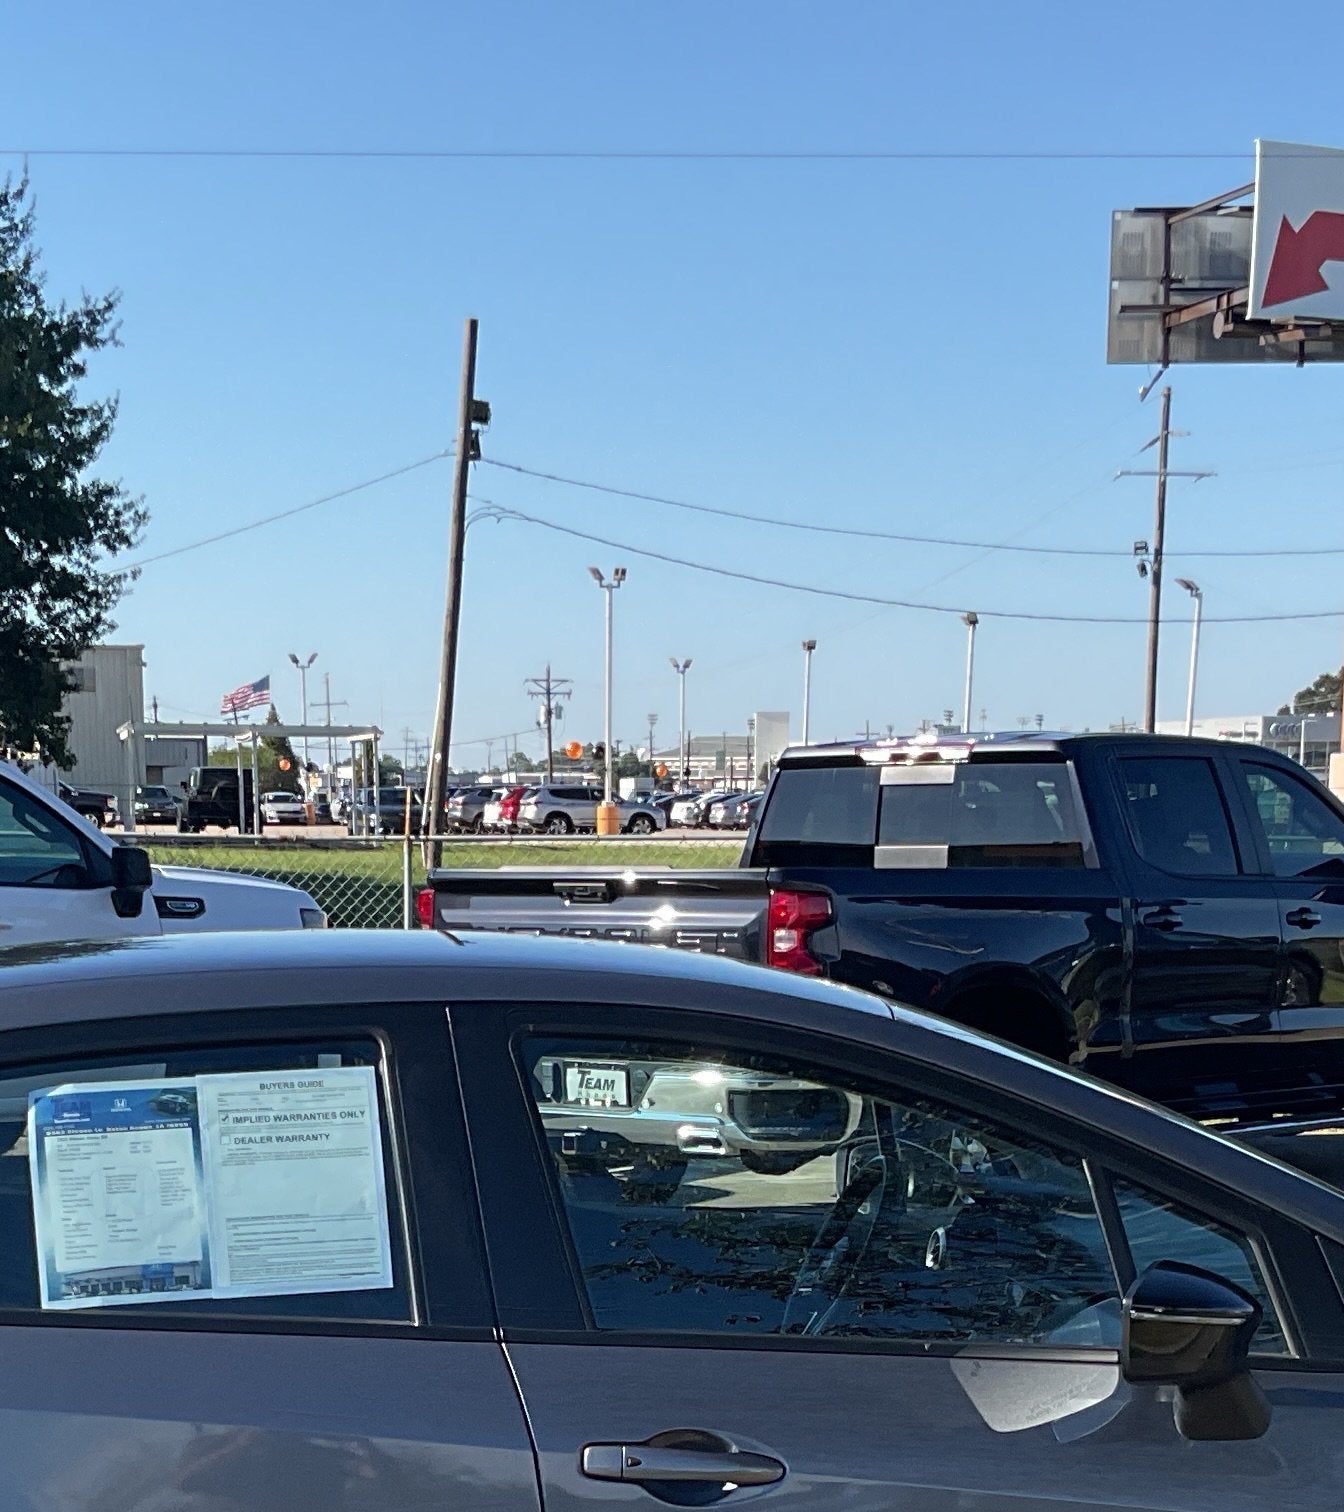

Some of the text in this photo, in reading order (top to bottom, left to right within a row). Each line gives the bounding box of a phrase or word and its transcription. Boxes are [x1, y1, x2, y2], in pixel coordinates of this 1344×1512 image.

[259, 1080, 324, 1090] BUYERS GUIDE
[577, 1070, 616, 1091] TEAM
[232, 1110, 366, 1124] IMPLIED WARRANTIES ONLY
[234, 1133, 331, 1145] DEALER WARRANTY
